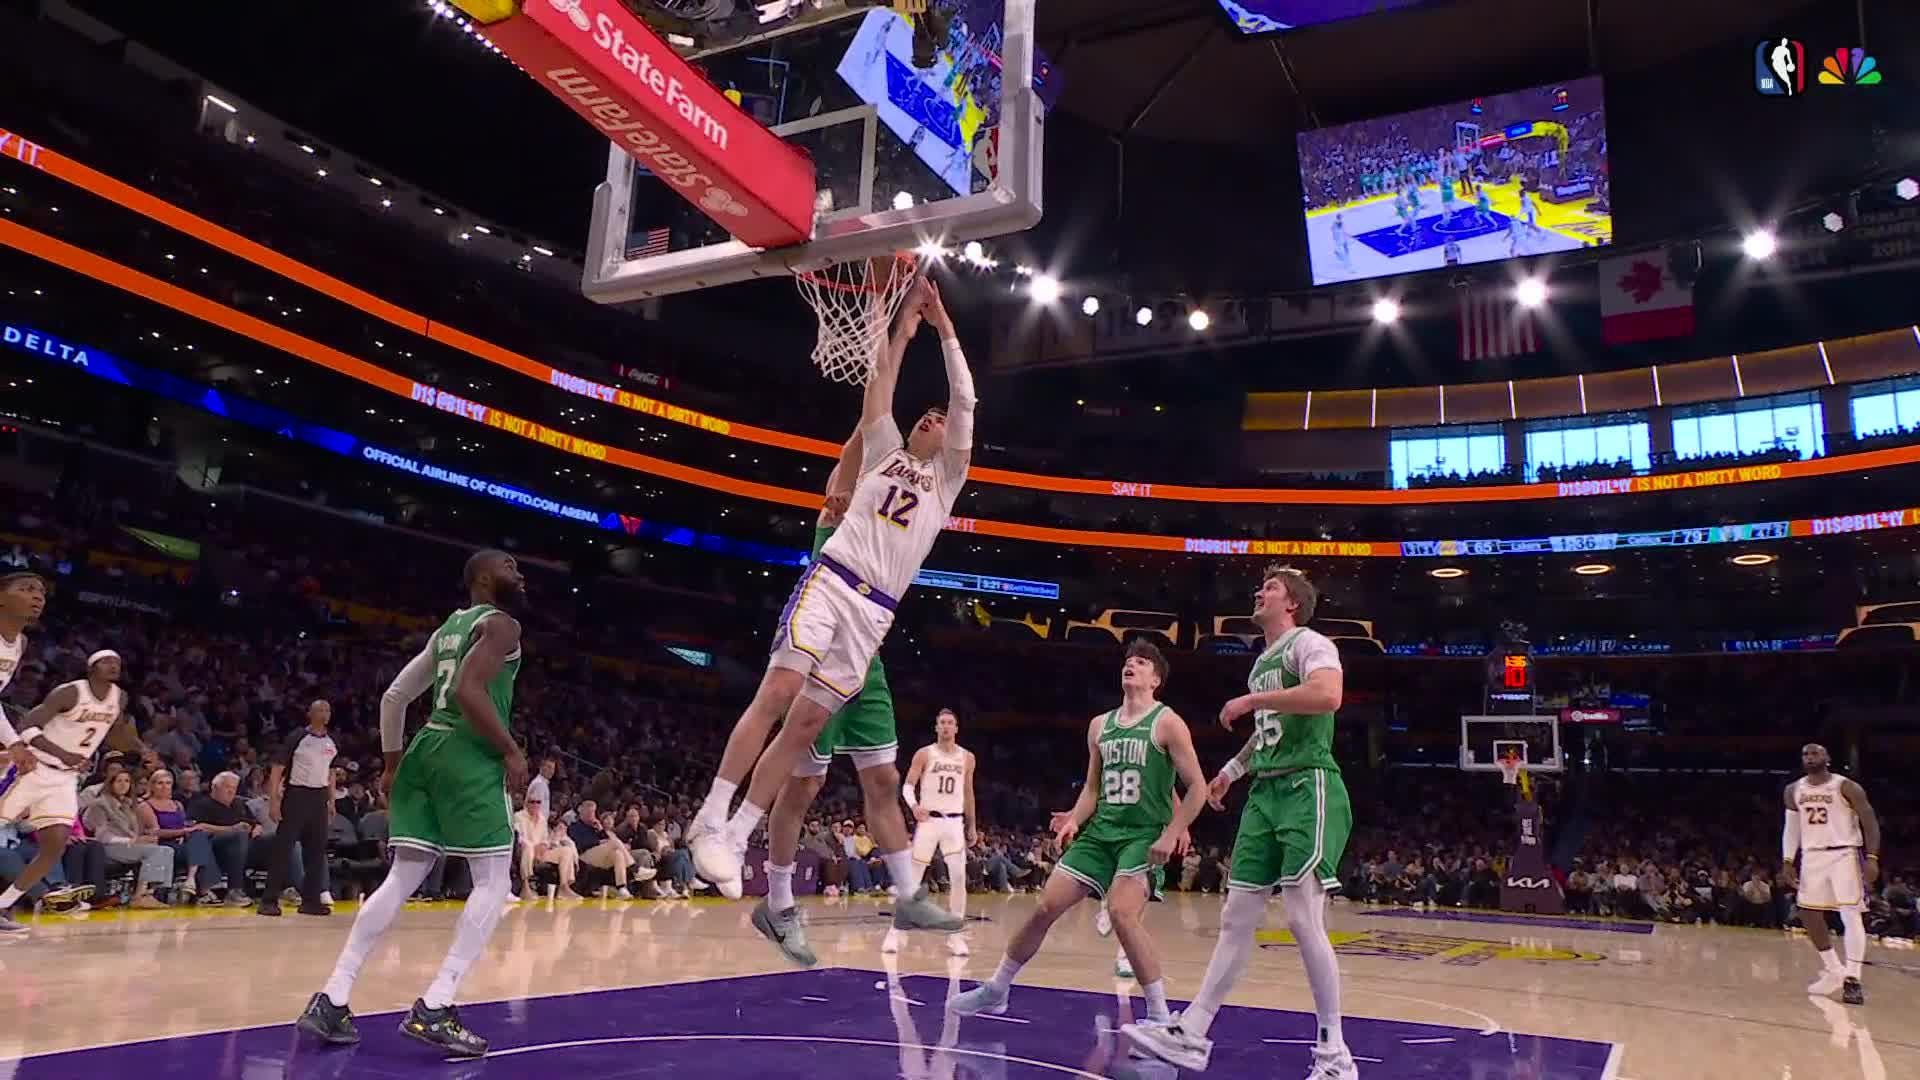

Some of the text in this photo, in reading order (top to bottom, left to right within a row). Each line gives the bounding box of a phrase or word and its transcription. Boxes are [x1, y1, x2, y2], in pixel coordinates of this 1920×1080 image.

[3, 326, 89, 367] DELTA
[503, 414, 530, 436] NOT
[529, 423, 537, 440] A
[363, 446, 600, 523] OFFICIAL AIRLINE OF CRYPTO.COM ARENA
[1111, 481, 1153, 498] SAY IT
[1637, 476, 1650, 491] IS
[1653, 474, 1680, 490] NOT
[1682, 473, 1693, 487] A
[1696, 468, 1736, 486] DIRTY
[1738, 465, 1782, 482] WORD
[878, 485, 919, 530] 12
[1267, 541, 1290, 555] NOT
[1292, 541, 1301, 555] A
[1559, 536, 1597, 550] 1:36
[437, 659, 457, 709] 7
[1505, 667, 1525, 688] 10
[79, 727, 97, 748] 2
[938, 775, 956, 794] 10
[1103, 769, 1141, 804] 28
[1806, 807, 1828, 825] 23
